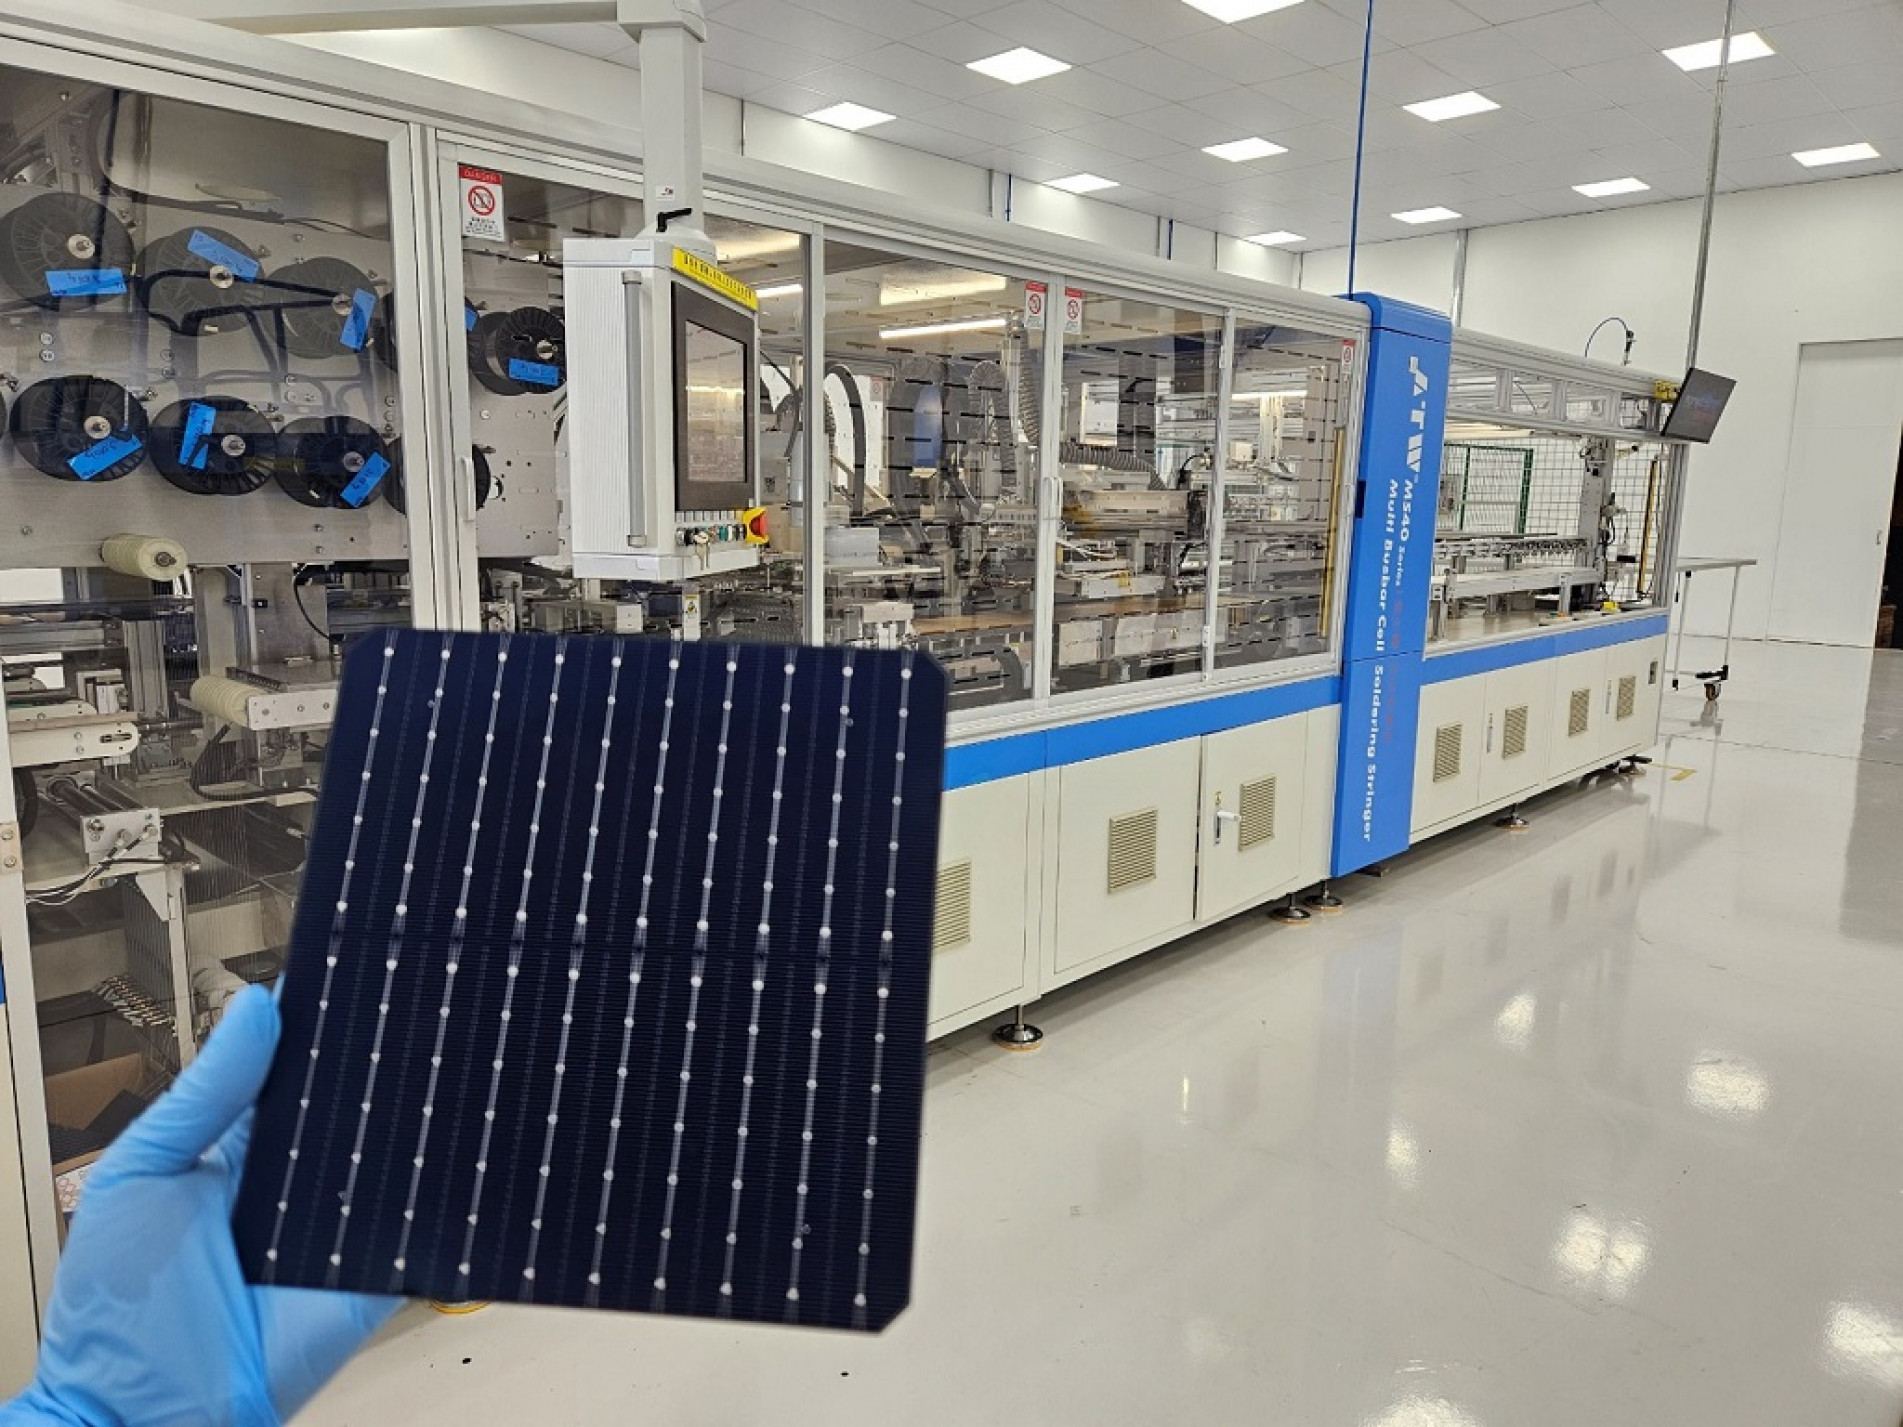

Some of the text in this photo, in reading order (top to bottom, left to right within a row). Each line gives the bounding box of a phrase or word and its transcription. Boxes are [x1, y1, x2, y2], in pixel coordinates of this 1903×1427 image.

[1401, 479, 1413, 542] MS40
[1395, 546, 1406, 586] Series
[1362, 479, 1398, 842] Multi Busbar Cell Soldering Stringer
